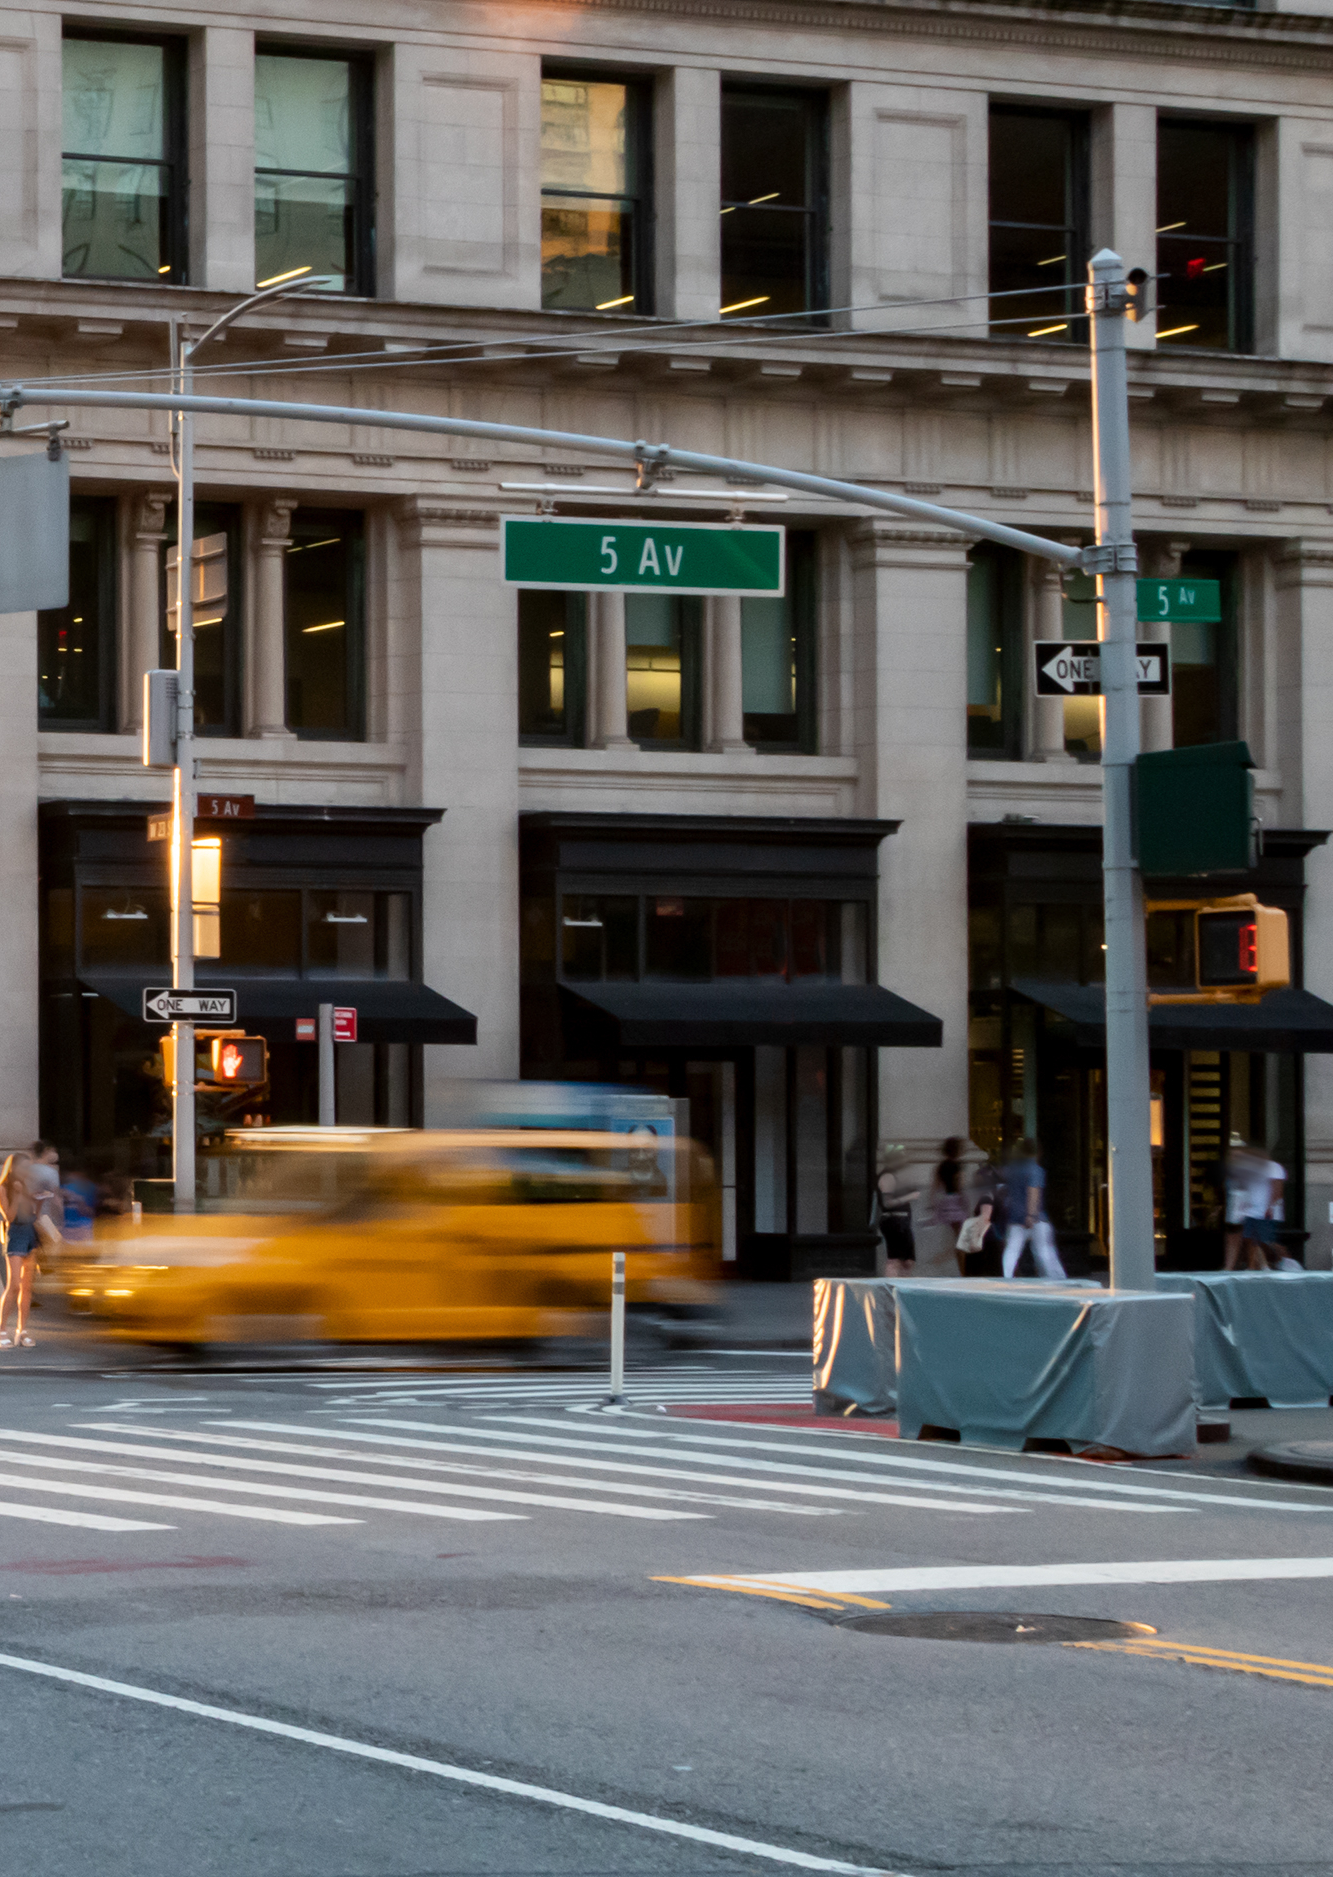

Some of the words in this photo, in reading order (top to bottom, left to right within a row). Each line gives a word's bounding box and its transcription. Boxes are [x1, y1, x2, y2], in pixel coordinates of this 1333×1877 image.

[601, 536, 618, 574] 5
[638, 537, 683, 576] Av
[1158, 586, 1169, 616] 5
[1179, 587, 1195, 604] Av
[1056, 660, 1093, 679] ONE
[211, 800, 219, 815] 5
[223, 801, 240, 816] Av
[157, 999, 183, 1011] ONE
[198, 1000, 226, 1011] WAY
